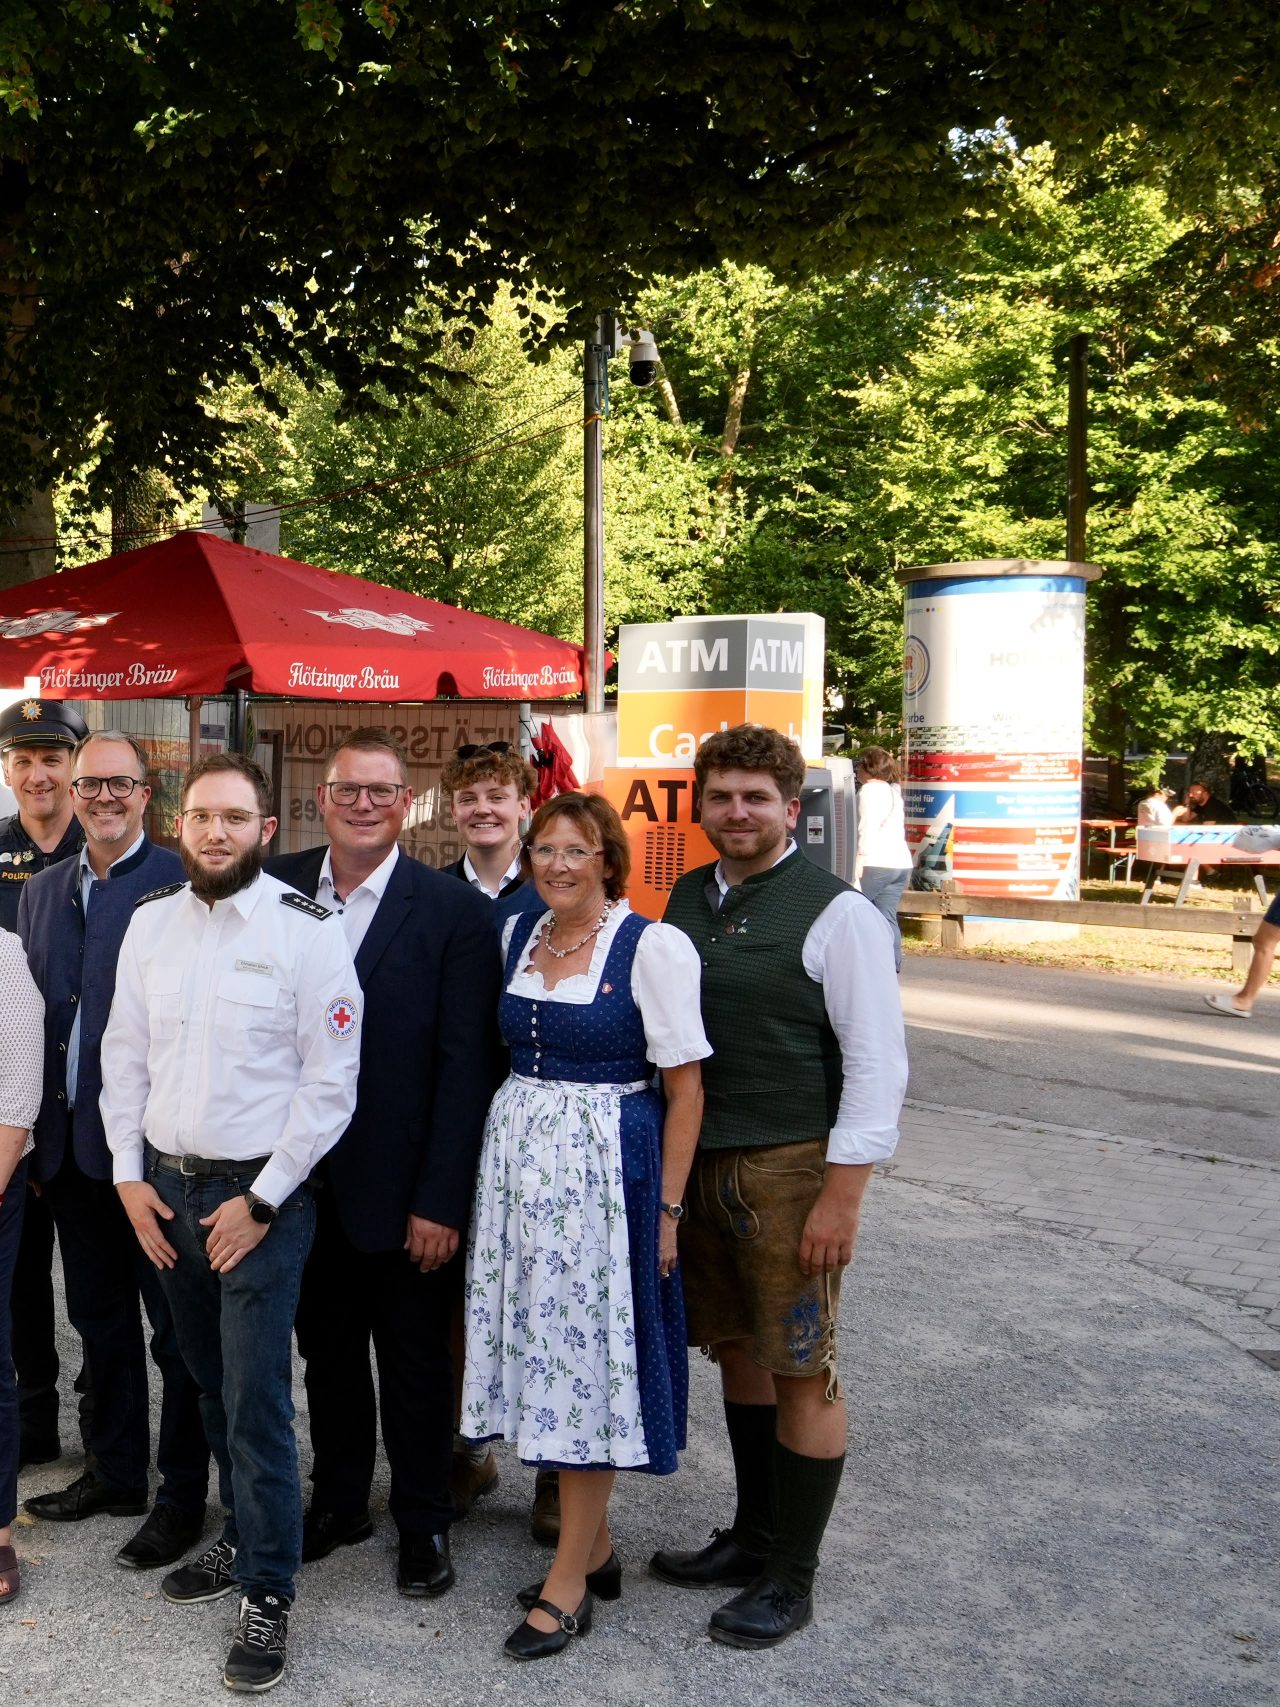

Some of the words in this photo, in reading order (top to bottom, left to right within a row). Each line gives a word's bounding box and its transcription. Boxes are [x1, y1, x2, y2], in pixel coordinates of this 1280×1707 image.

[636, 638, 729, 674] ATM
[749, 638, 803, 674] ATM
[40, 666, 124, 692] Flötzinger
[126, 662, 178, 686] Bräu
[288, 662, 358, 693] Flötzinger
[358, 666, 400, 689] Bräu
[482, 665, 538, 691] Flötzinger
[539, 664, 577, 686] Bräu
[621, 779, 701, 824] AT
[328, 999, 356, 1016] DEUTSCHES
[340, 1019, 357, 1037] KREUZ
